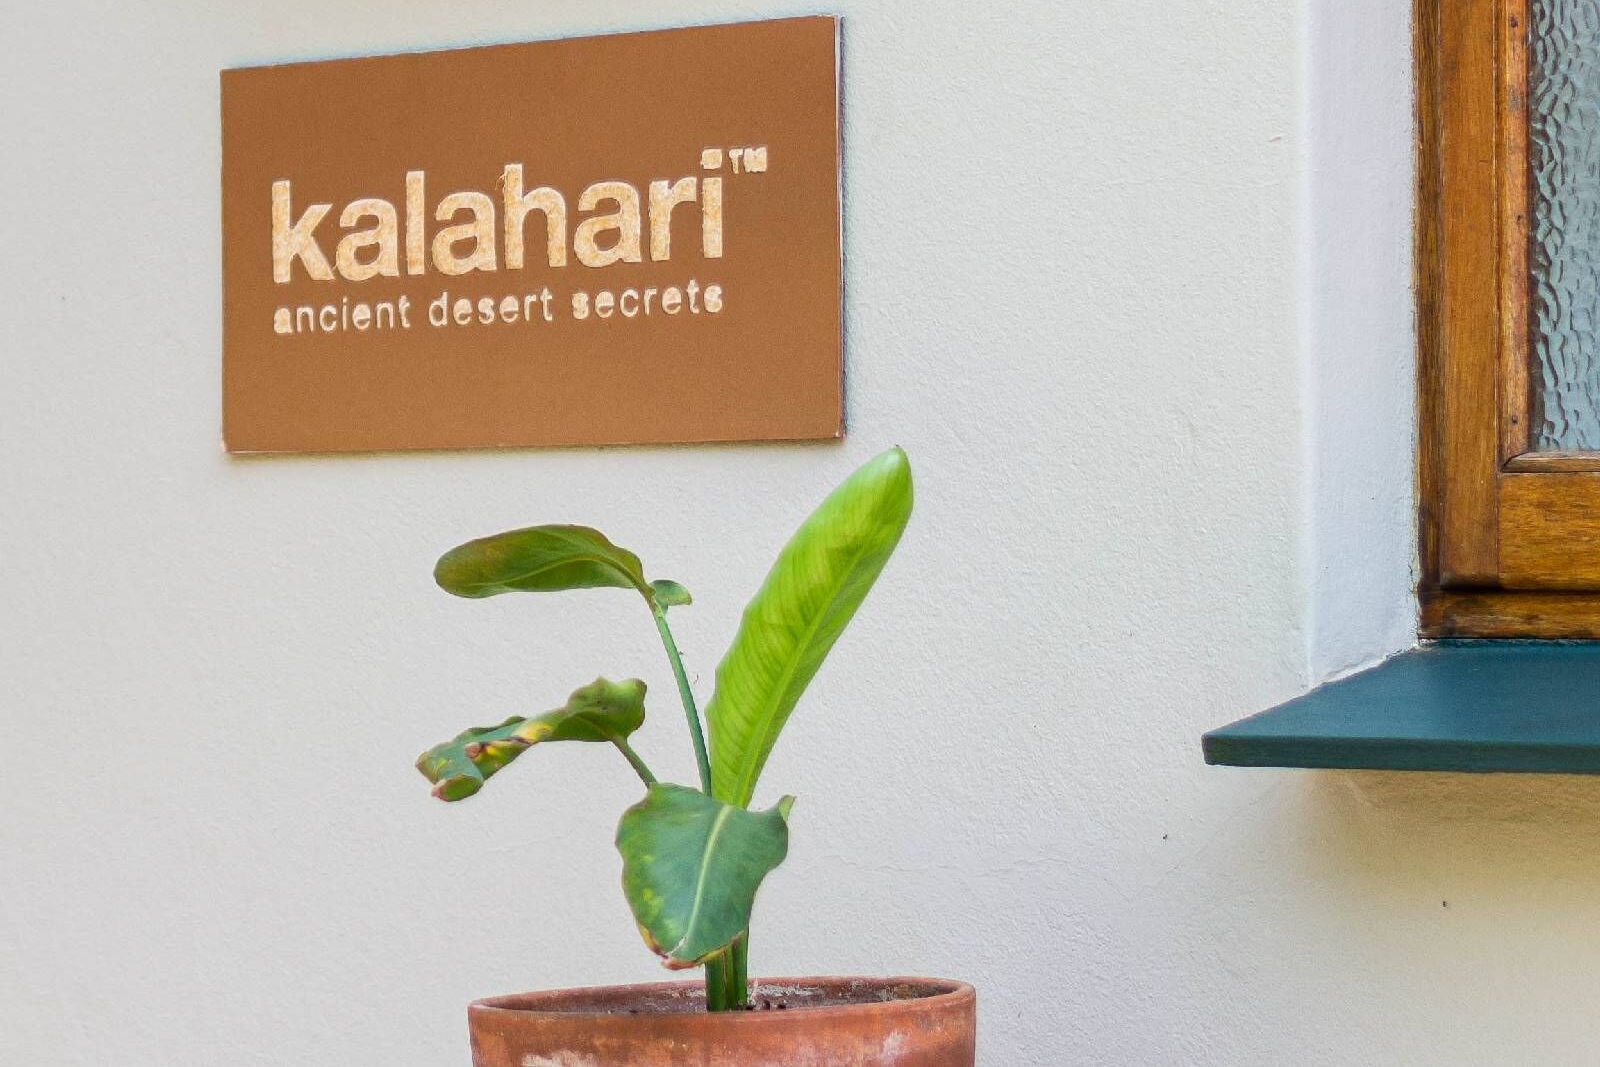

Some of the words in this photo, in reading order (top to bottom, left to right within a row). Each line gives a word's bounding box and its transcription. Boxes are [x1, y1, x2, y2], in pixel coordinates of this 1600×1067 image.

[273, 294, 411, 334] ancient
[428, 287, 553, 327] desert
[571, 279, 723, 320] secrets
